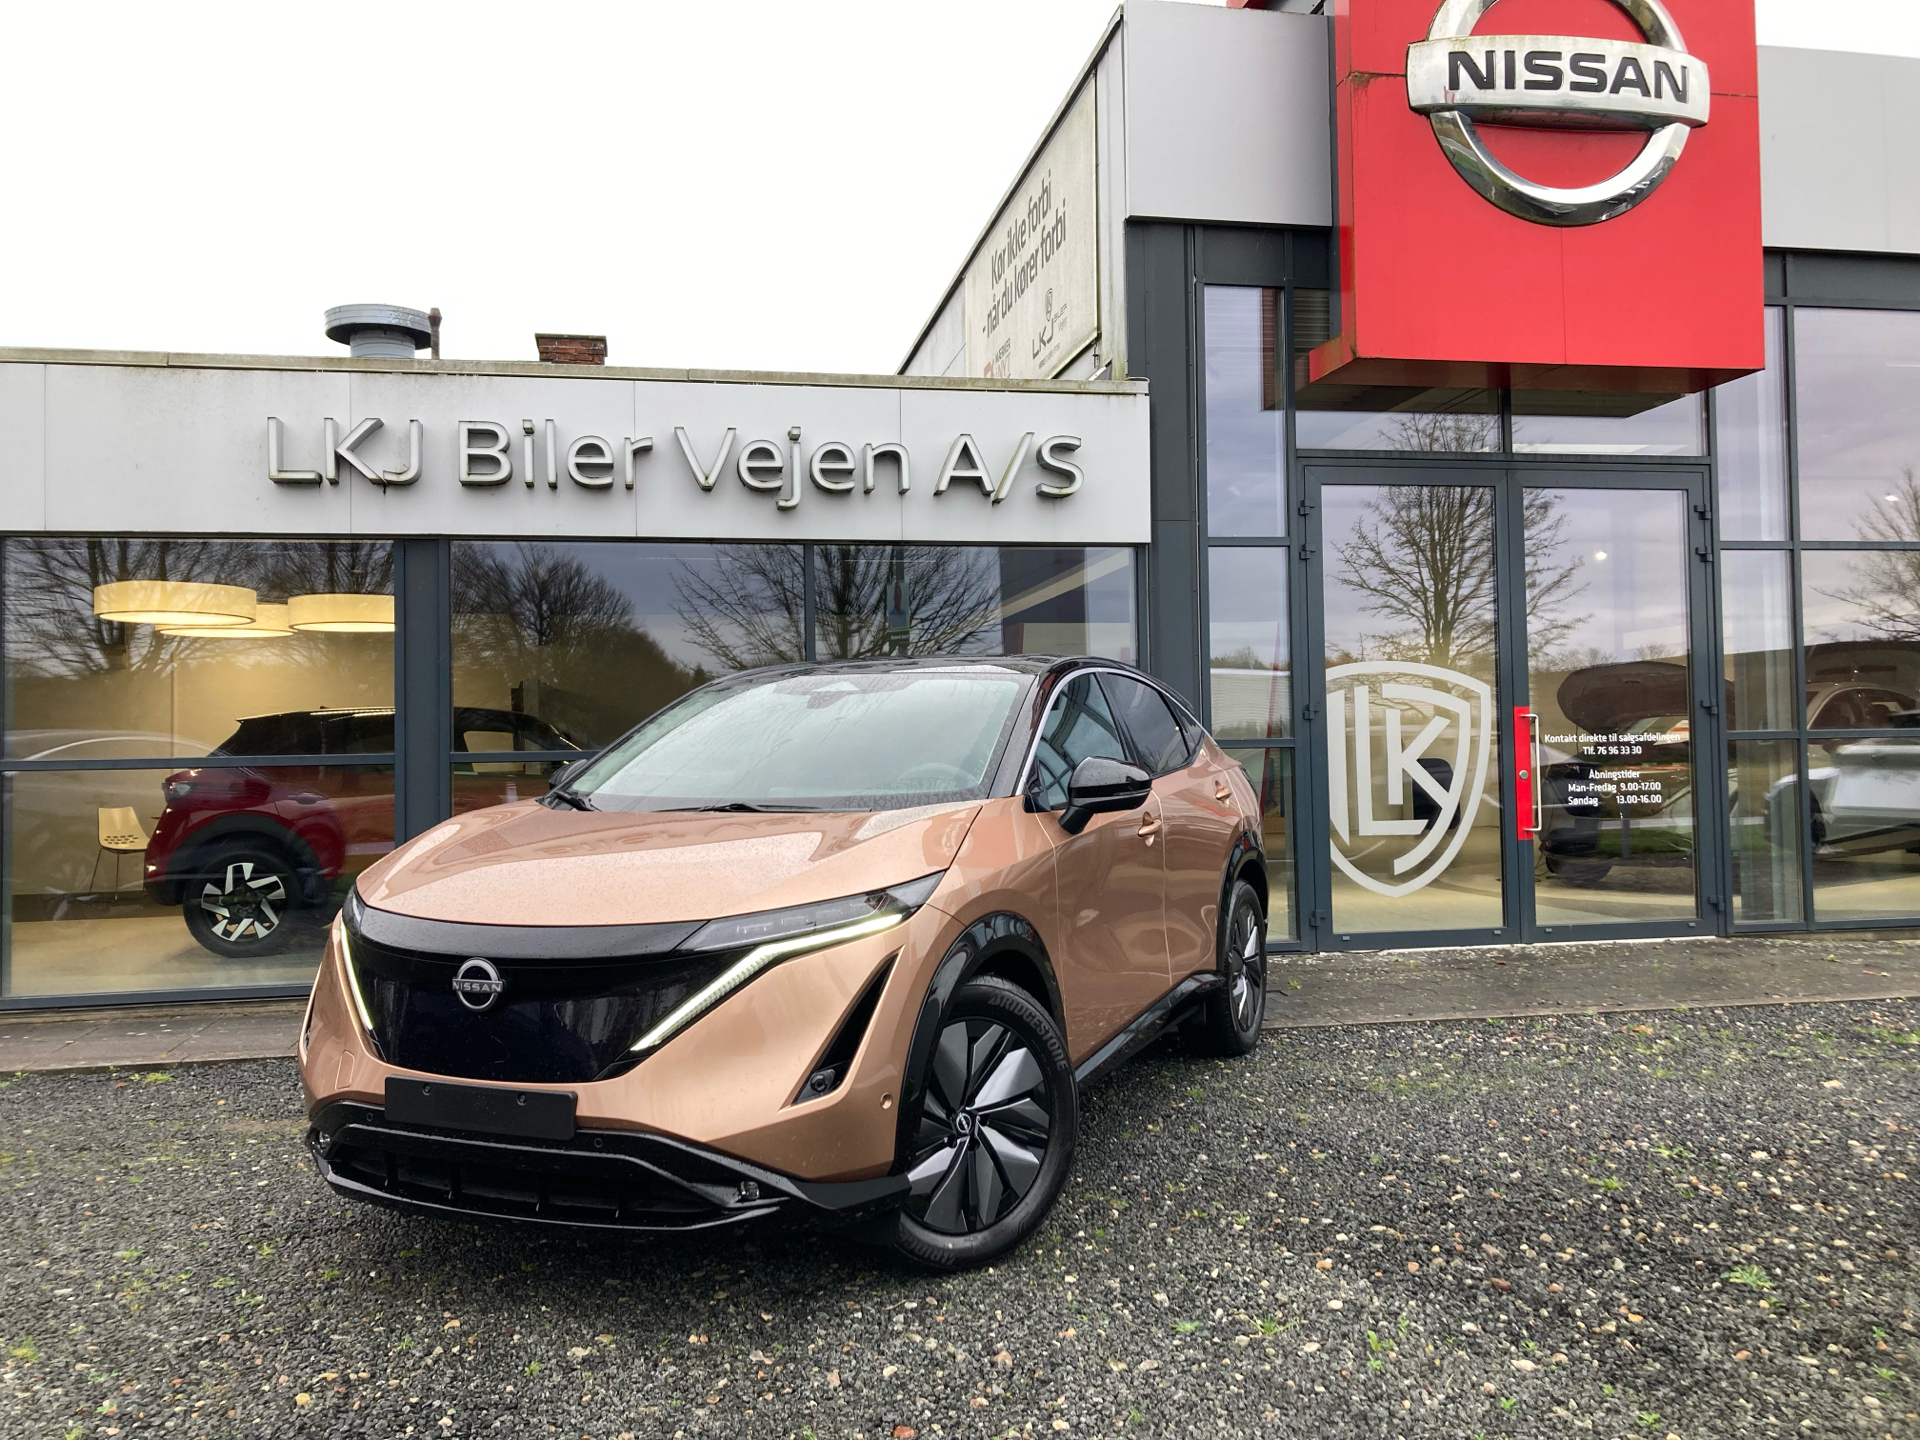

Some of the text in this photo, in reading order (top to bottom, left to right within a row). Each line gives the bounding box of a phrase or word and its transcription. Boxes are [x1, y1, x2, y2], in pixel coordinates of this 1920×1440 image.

[1448, 49, 1689, 104] NISSAN
[991, 168, 1052, 290] Kør ikke forbi
[1001, 277, 1013, 320] du
[1014, 245, 1040, 304] kører
[1040, 197, 1067, 270] forbi
[1032, 316, 1054, 360] LKJ
[266, 416, 1085, 510] LKJ Biler Vejen A/S
[1544, 732, 1681, 744] Kontakt direkte til salgsafdelingen
[1597, 746, 1607, 755] 76
[1608, 746, 1619, 755] 96
[1620, 745, 1630, 755] 33
[1631, 745, 1642, 755] 30
[1568, 781, 1661, 793] Man-Fredag 9.00-17.00
[1568, 794, 1662, 807] Søndag 13.00-16.00
[452, 980, 501, 992] NISSAN
[987, 992, 1068, 1071] BRIDGESTONE
